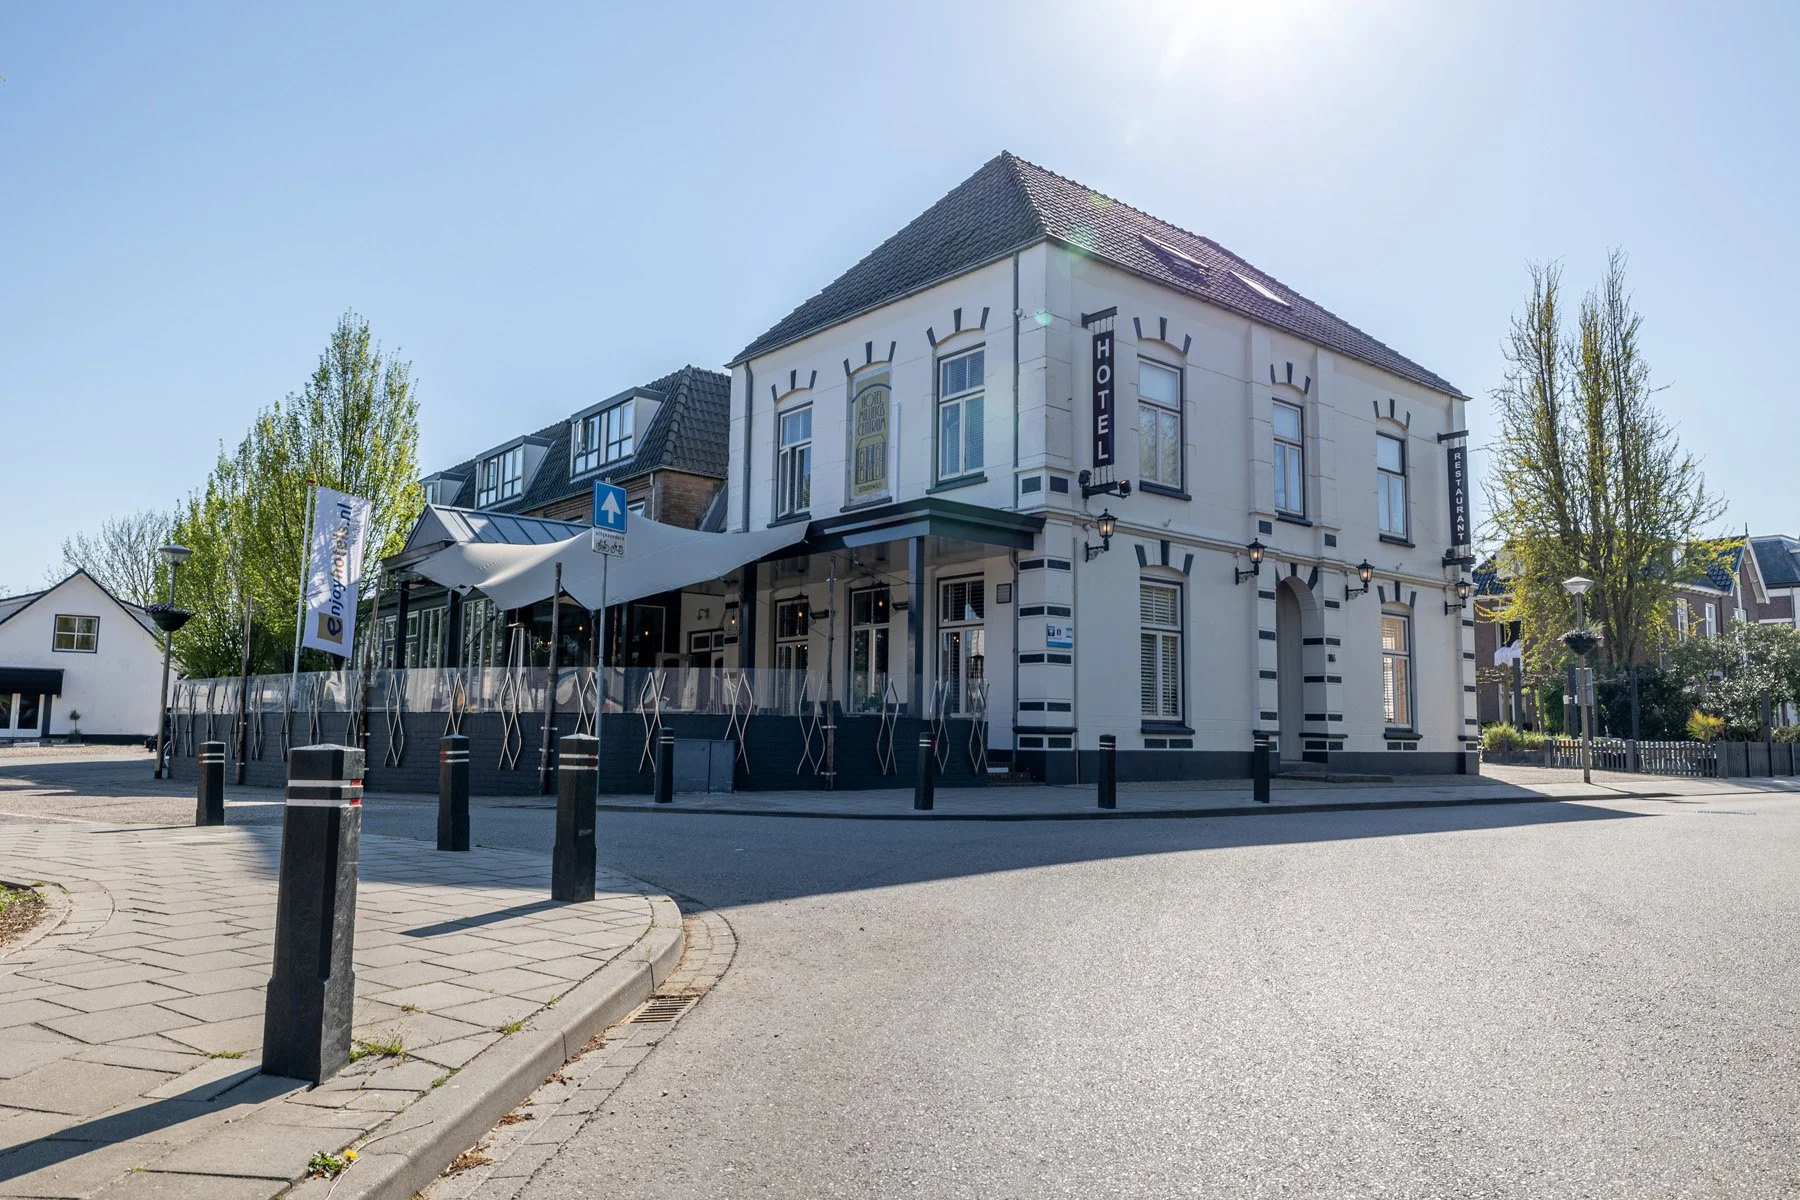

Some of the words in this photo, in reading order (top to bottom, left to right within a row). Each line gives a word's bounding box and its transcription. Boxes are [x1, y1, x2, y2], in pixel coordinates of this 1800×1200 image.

[857, 417, 886, 436] CENTRUM
[861, 390, 883, 408] HOTEL
[1096, 338, 1111, 460] HOTEL
[1454, 452, 1465, 541] RESTAURANT
[327, 503, 353, 637] enjoyhotels.nl
